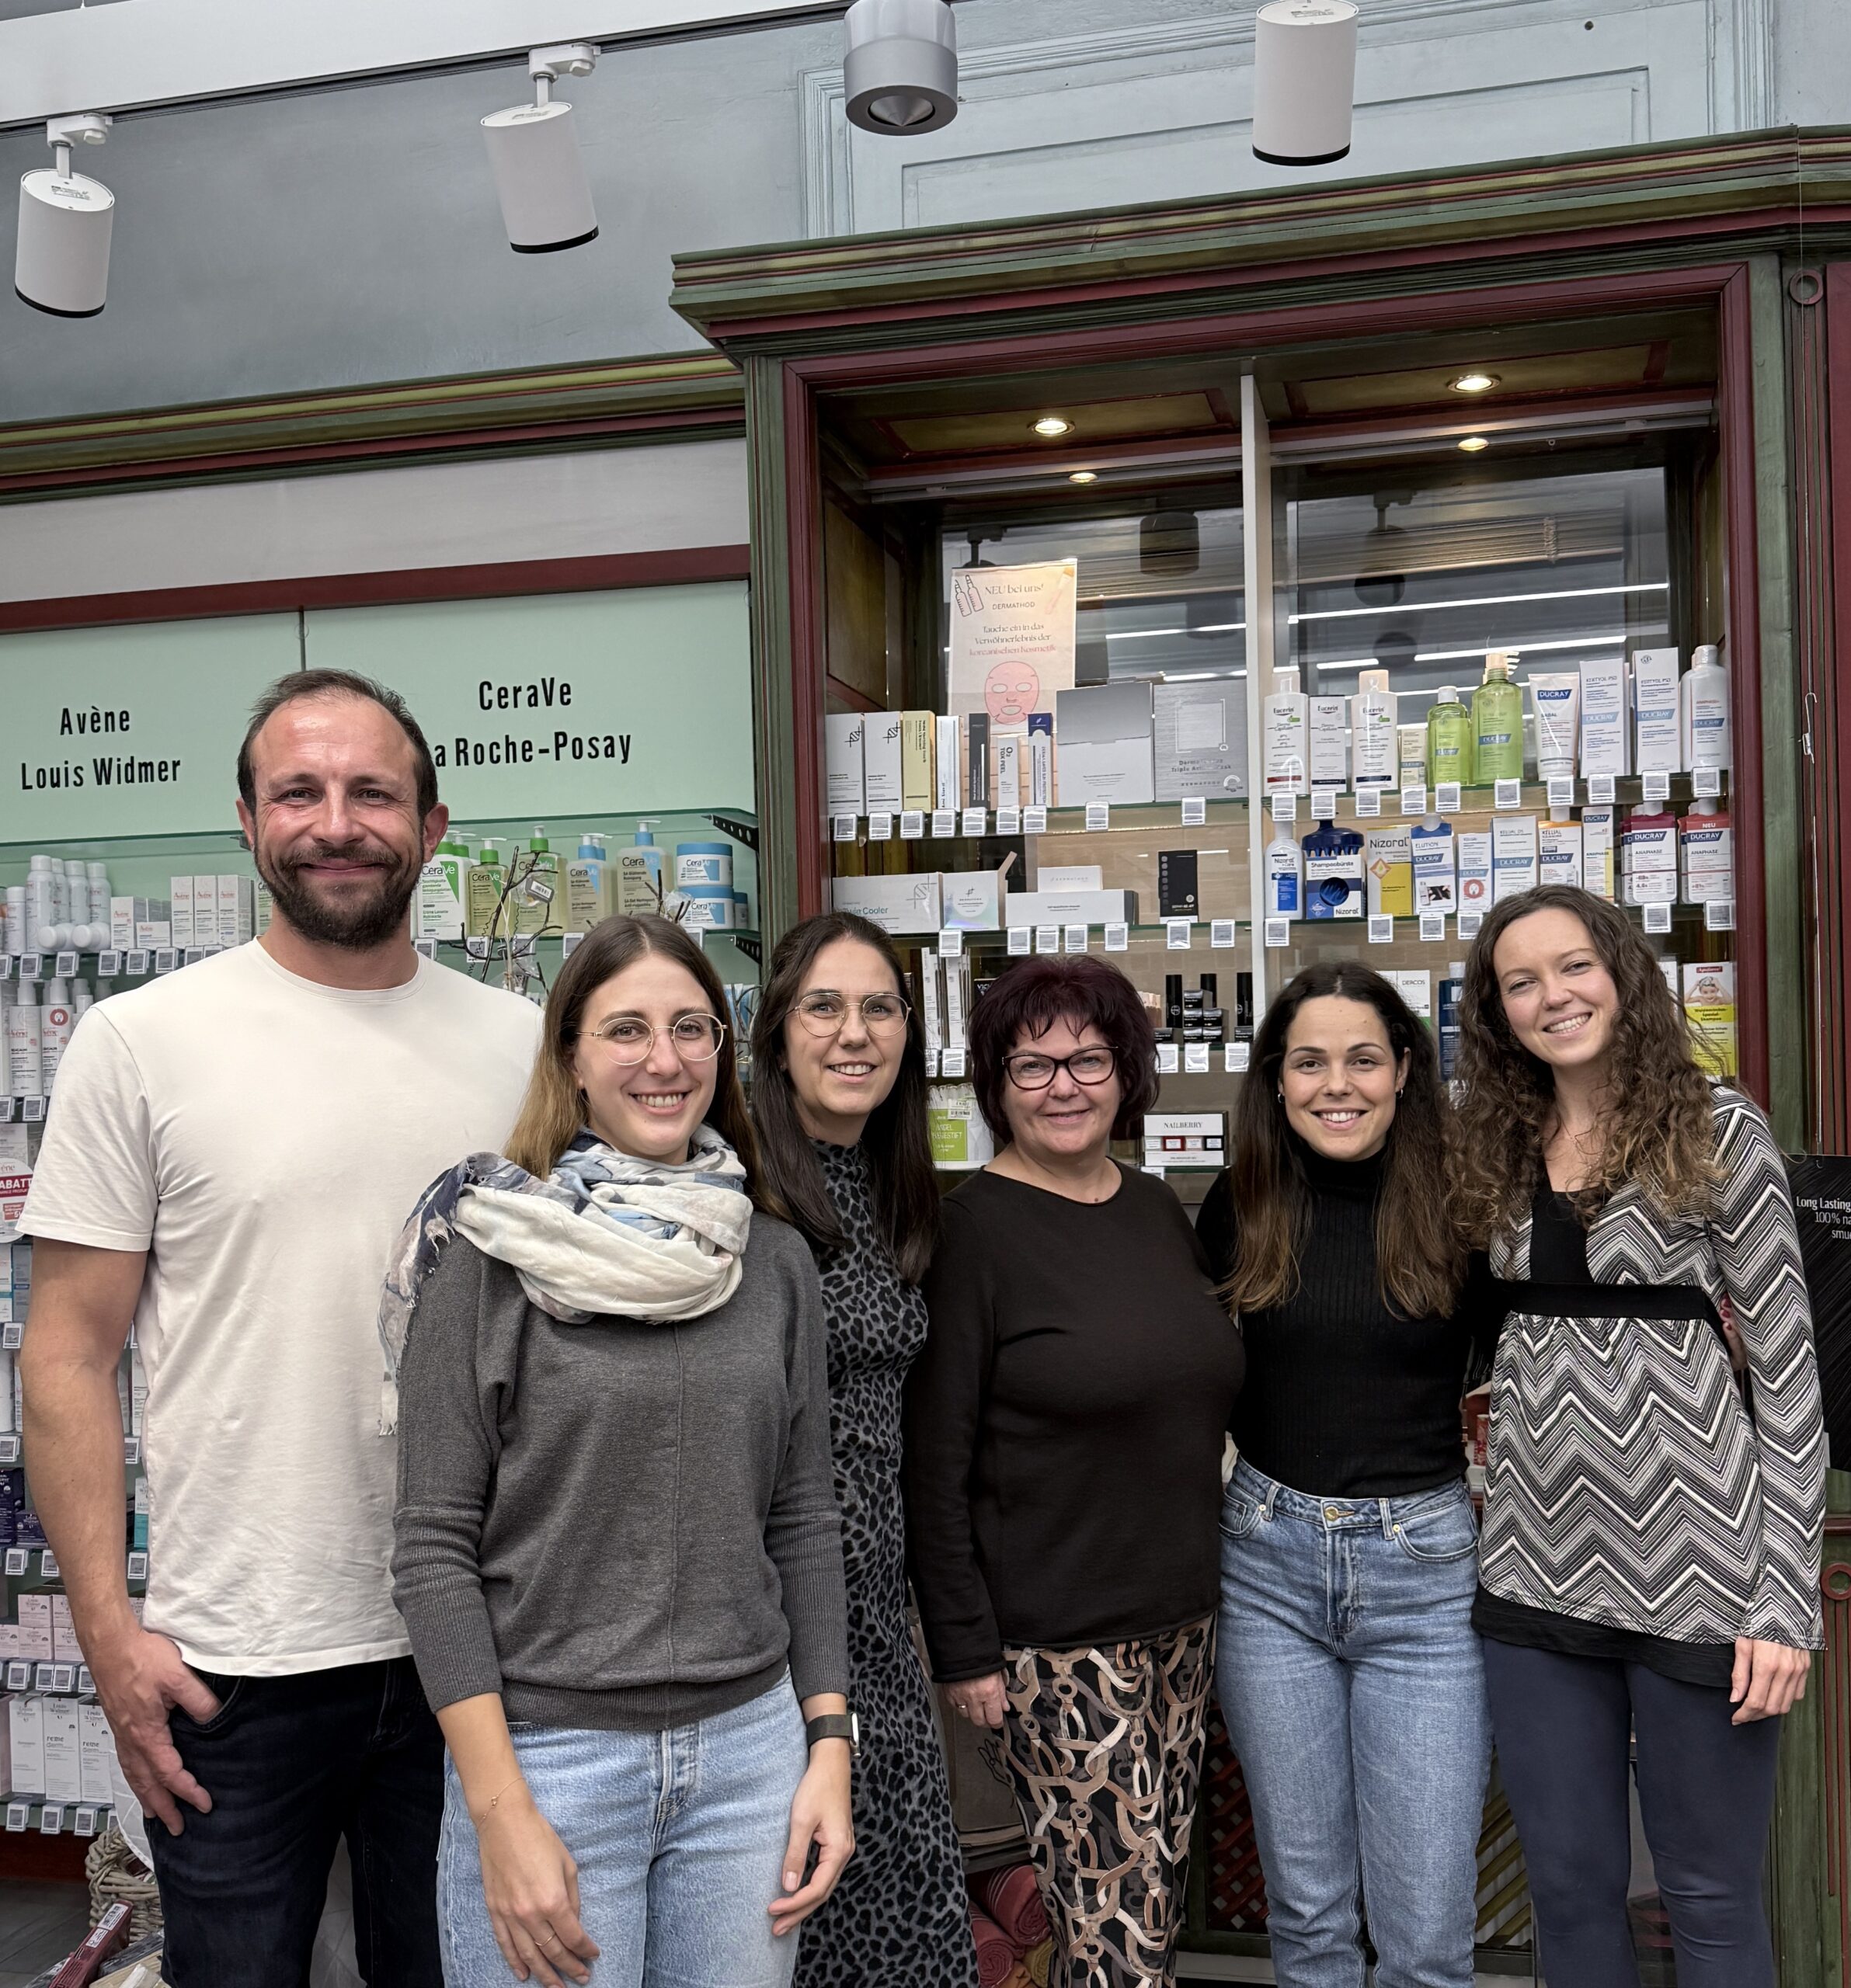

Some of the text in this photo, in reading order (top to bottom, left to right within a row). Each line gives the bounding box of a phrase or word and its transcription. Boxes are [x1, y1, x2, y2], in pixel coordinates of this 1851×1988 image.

[986, 586, 1006, 595] NEU
[1007, 584, 1021, 594] bei
[992, 601, 1035, 610] DERMATHOD
[983, 624, 1008, 634] Tauche
[1031, 622, 1044, 631] das
[479, 677, 572, 711] CeraVe
[60, 705, 130, 735] Avène
[455, 731, 631, 767] Roche-Posay
[21, 756, 181, 790] Louis Widmer
[1369, 836, 1409, 849] Nizoral
[422, 864, 455, 875] CeraVe
[472, 873, 499, 881] CeraVe
[1796, 1196, 1851, 1213] Long Lasting
[1814, 1212, 1841, 1225] 100%
